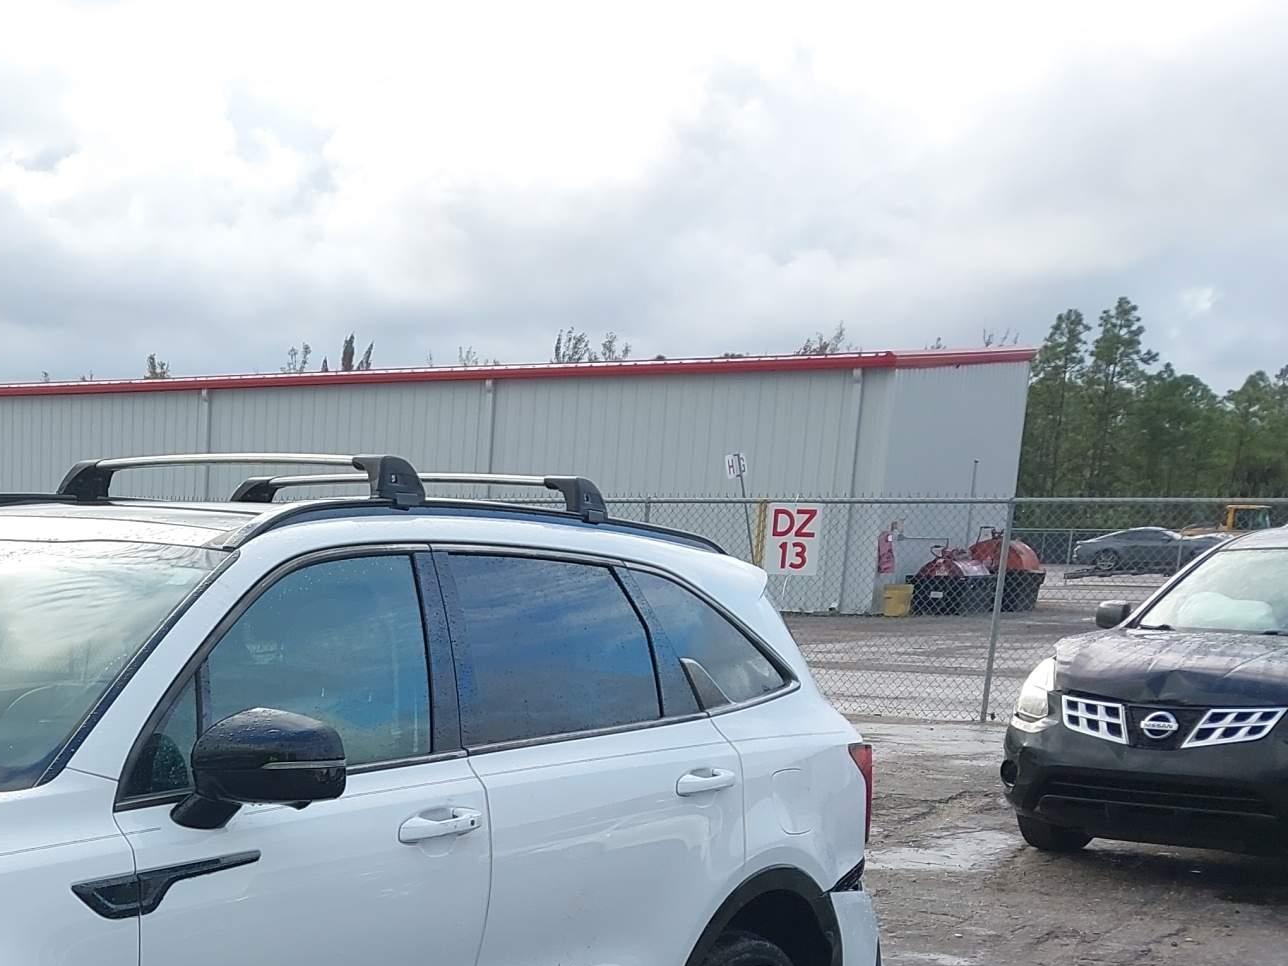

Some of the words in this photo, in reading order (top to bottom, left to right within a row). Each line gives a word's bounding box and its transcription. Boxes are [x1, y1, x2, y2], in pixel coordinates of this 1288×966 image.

[727, 458, 736, 475] H
[772, 508, 818, 538] DZ
[778, 541, 807, 569] 13
